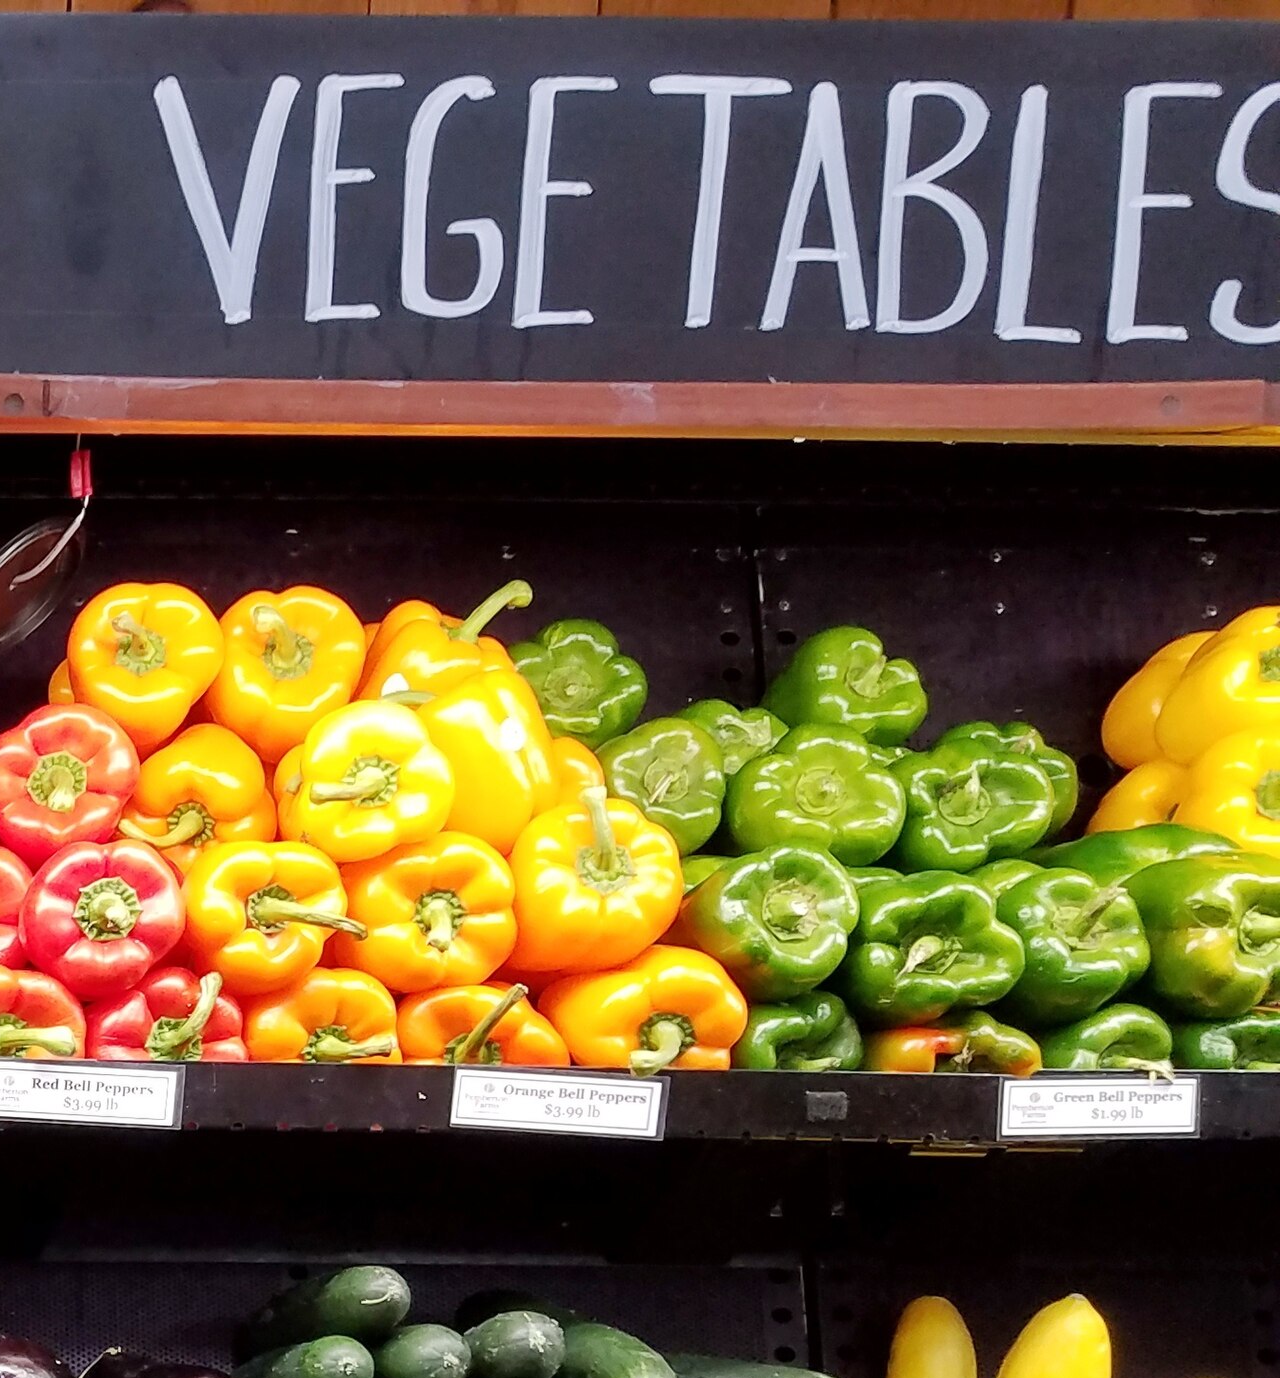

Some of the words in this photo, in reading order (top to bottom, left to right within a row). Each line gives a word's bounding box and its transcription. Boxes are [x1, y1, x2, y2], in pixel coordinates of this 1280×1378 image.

[152, 73, 1280, 344] VEGETABLES
[31, 1077, 59, 1090] Red
[64, 1079, 90, 1092] Bell
[95, 1081, 154, 1096] Peppers
[503, 1083, 554, 1099] Orange
[558, 1087, 585, 1100] Bell
[590, 1089, 648, 1105] Peppers
[63, 1096, 102, 1111] $3.99
[106, 1097, 119, 1110] lb
[1053, 1092, 1095, 1103] Green
[1098, 1091, 1124, 1103] Bell
[1128, 1091, 1182, 1105] Peppers
[544, 1103, 584, 1118] $3.99
[587, 1104, 601, 1118] lb
[1091, 1107, 1127, 1121] $1.99
[1131, 1106, 1144, 1119] lb
